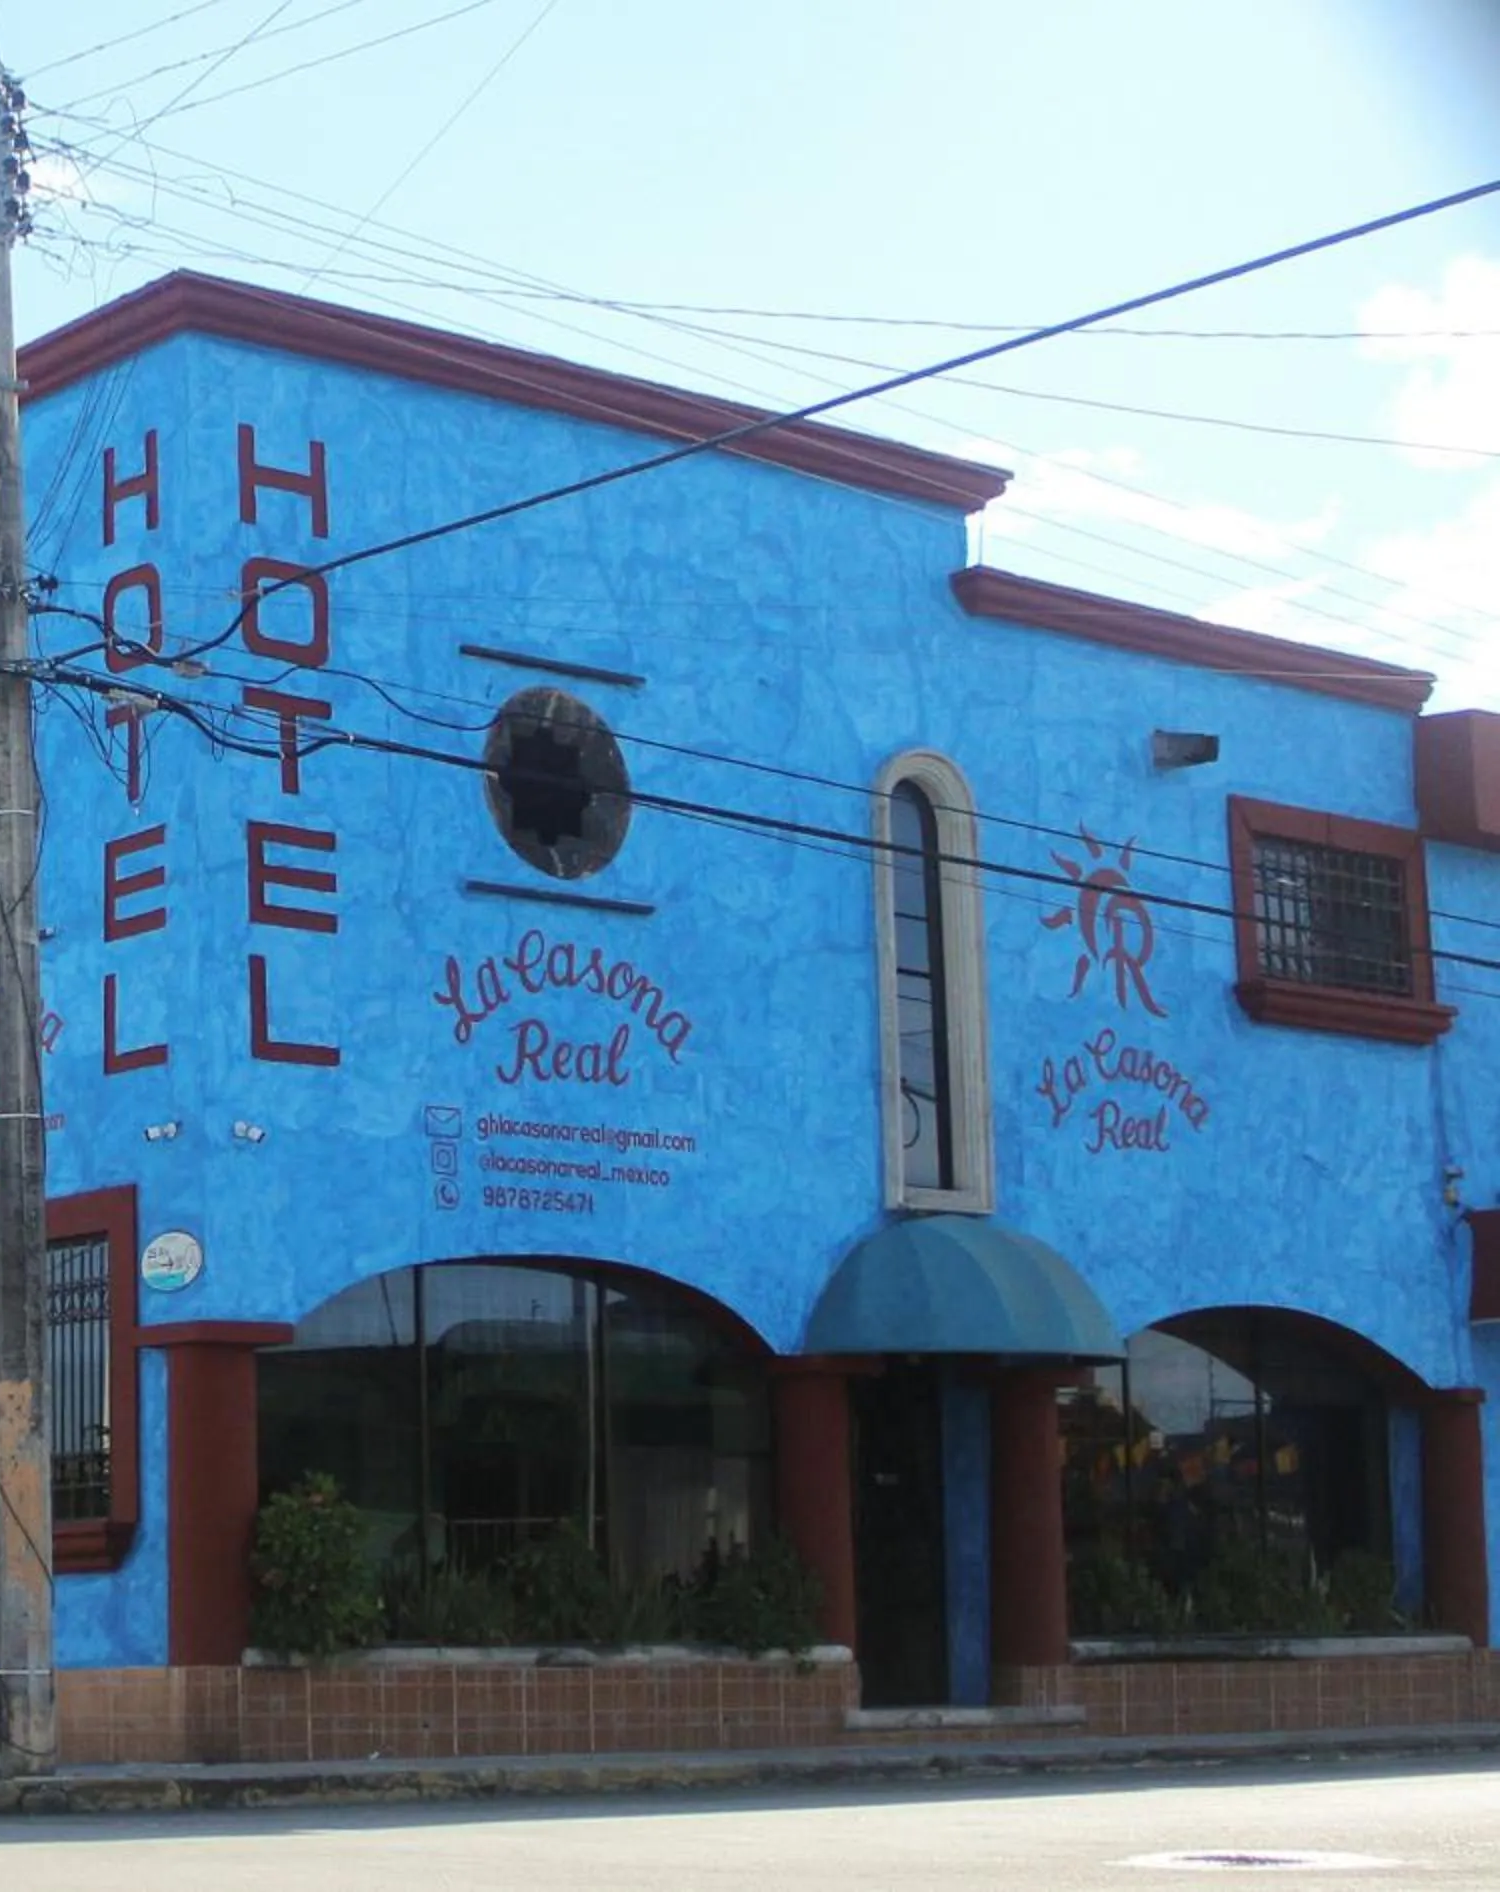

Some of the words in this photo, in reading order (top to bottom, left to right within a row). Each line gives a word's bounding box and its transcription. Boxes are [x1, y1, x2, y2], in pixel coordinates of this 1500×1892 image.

[104, 429, 168, 1075] HOTEL
[238, 423, 340, 1067] HOTEL
[433, 955, 511, 1044] La
[503, 929, 692, 1065] Casona
[496, 1018, 630, 1086] Real
[1036, 1056, 1088, 1129] La
[1084, 1028, 1210, 1132] Casona
[1085, 1100, 1170, 1154] Real
